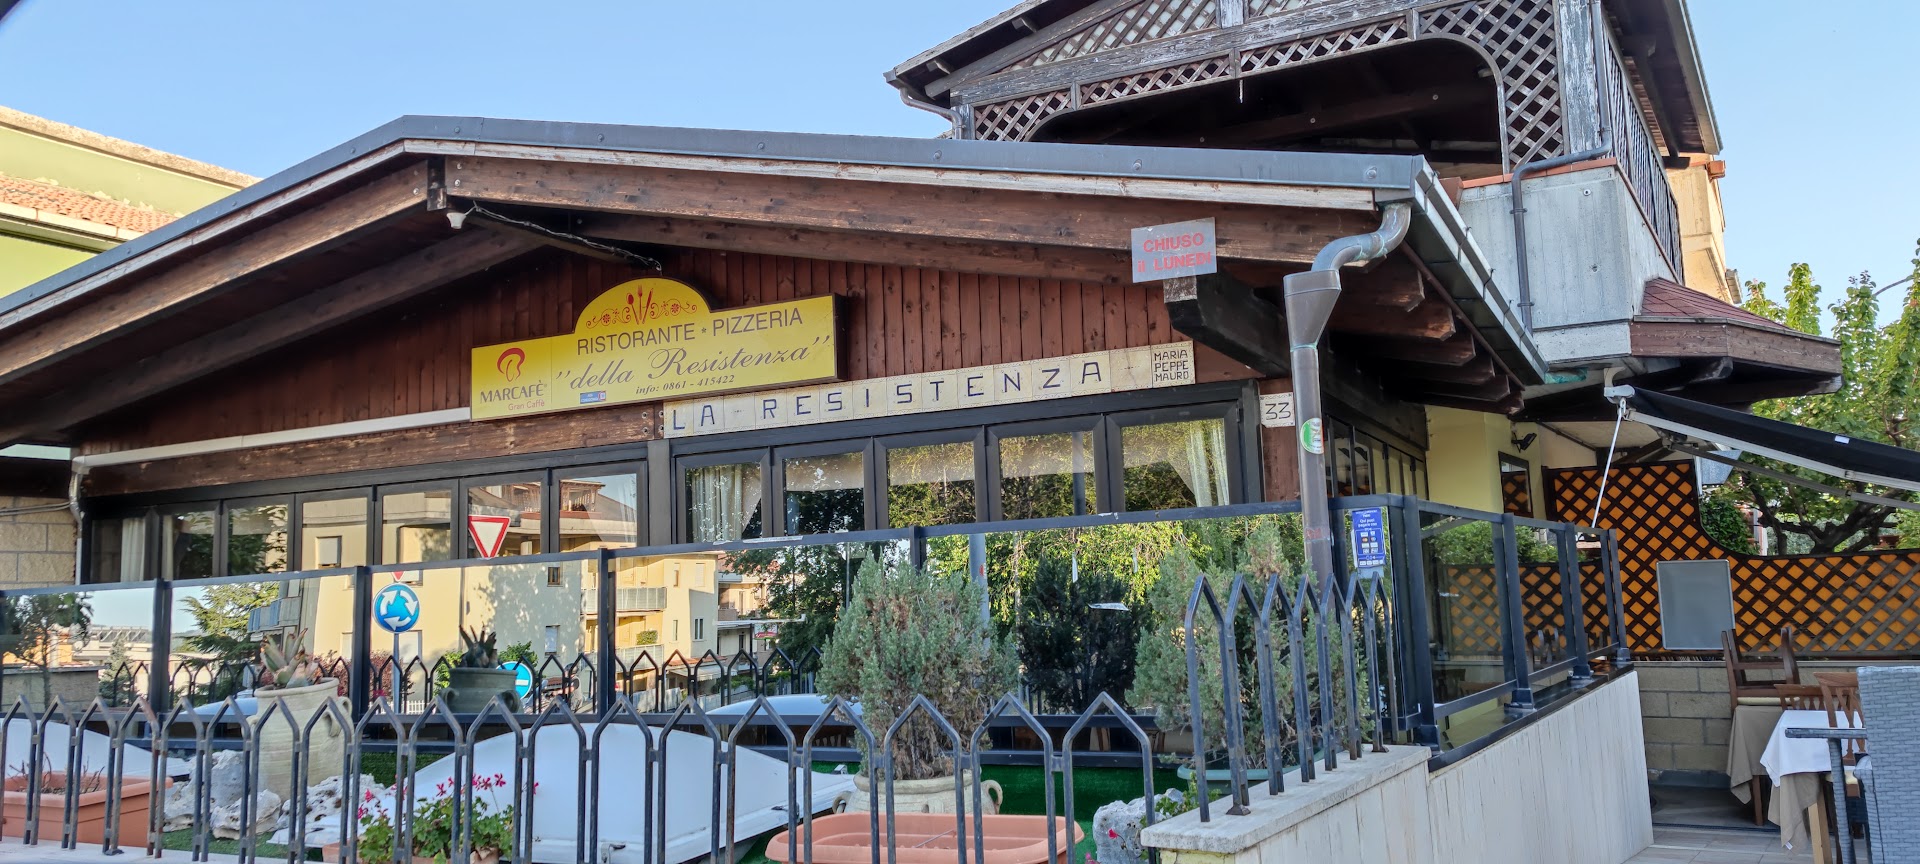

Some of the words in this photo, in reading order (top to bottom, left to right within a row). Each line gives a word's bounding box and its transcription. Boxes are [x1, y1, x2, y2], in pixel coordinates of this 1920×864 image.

[1143, 232, 1204, 253] CHIUSO
[577, 322, 695, 355] RISTORANTE
[713, 307, 803, 336] PIZZERIA
[1153, 350, 1188, 360] MARIA
[1154, 360, 1189, 372] PEPPE
[635, 384, 660, 395] info:
[663, 381, 687, 391] 0861
[697, 374, 735, 387] 415422
[1155, 371, 1189, 382] MAURO
[480, 379, 544, 404] MARCAFÈ
[672, 404, 715, 431] LA
[761, 361, 1102, 419] RESISTENZA
[508, 402, 525, 411] Gran
[526, 399, 545, 409] Caffè
[1264, 402, 1291, 420] 33
